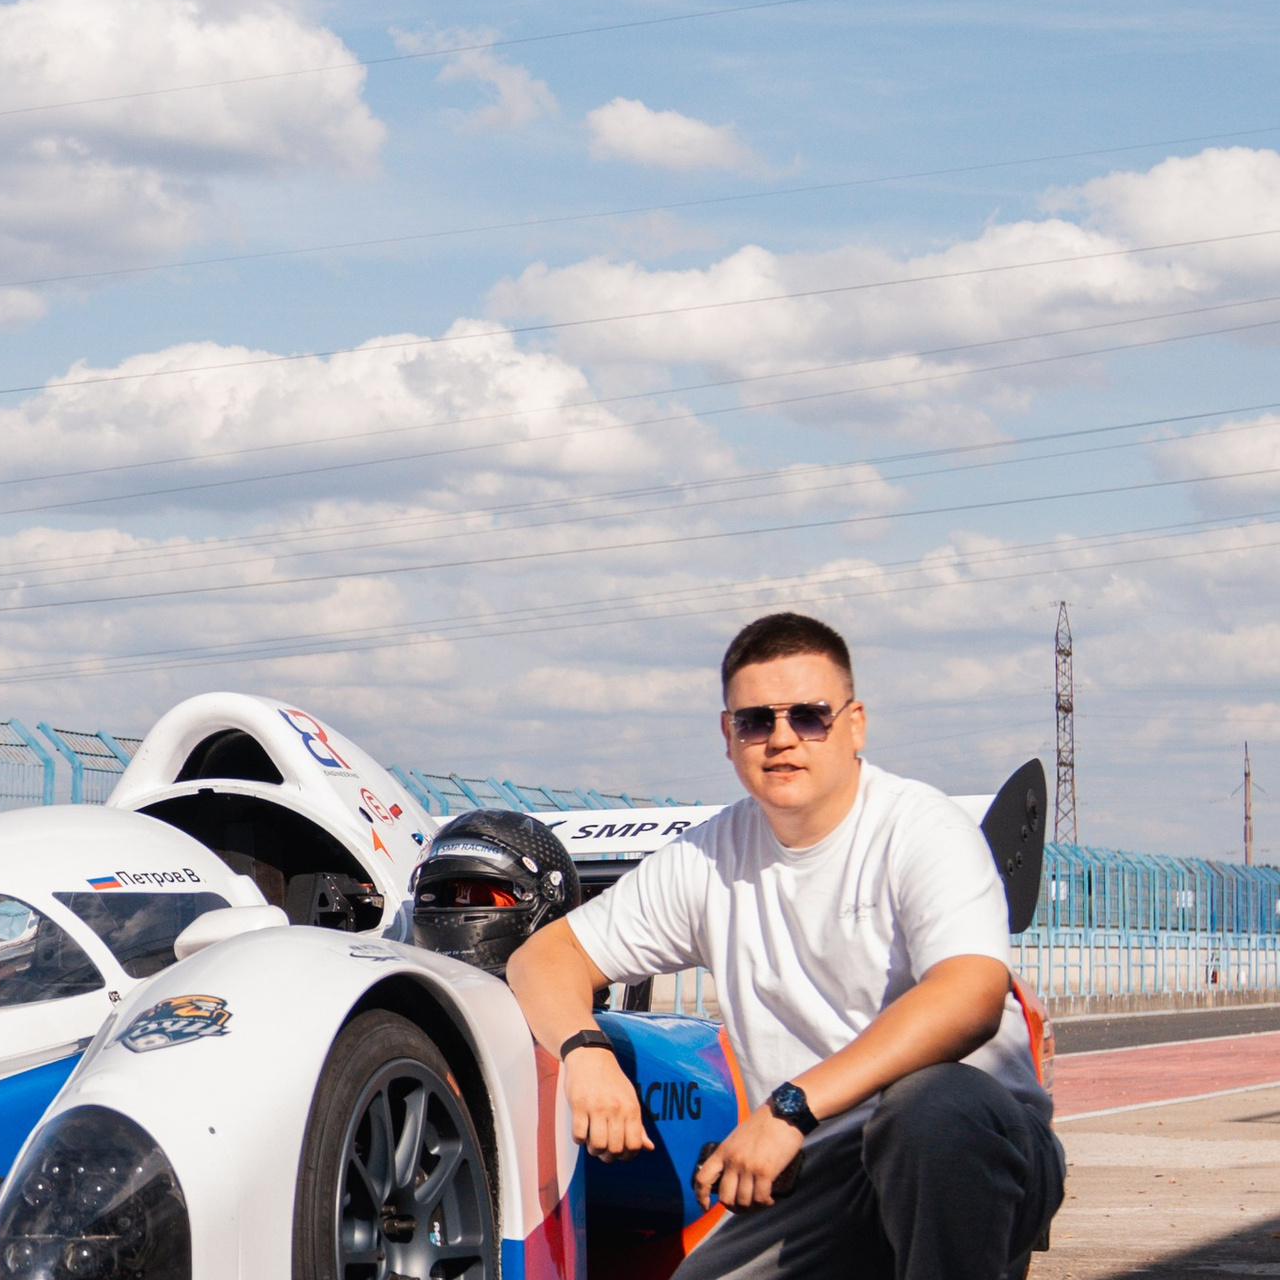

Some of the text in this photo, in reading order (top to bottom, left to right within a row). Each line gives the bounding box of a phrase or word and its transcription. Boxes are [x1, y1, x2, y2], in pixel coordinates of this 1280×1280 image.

[571, 822, 659, 840] SMP
[440, 843, 462, 853] SMP
[461, 843, 501, 854] RACING
[115, 871, 186, 887] Петров
